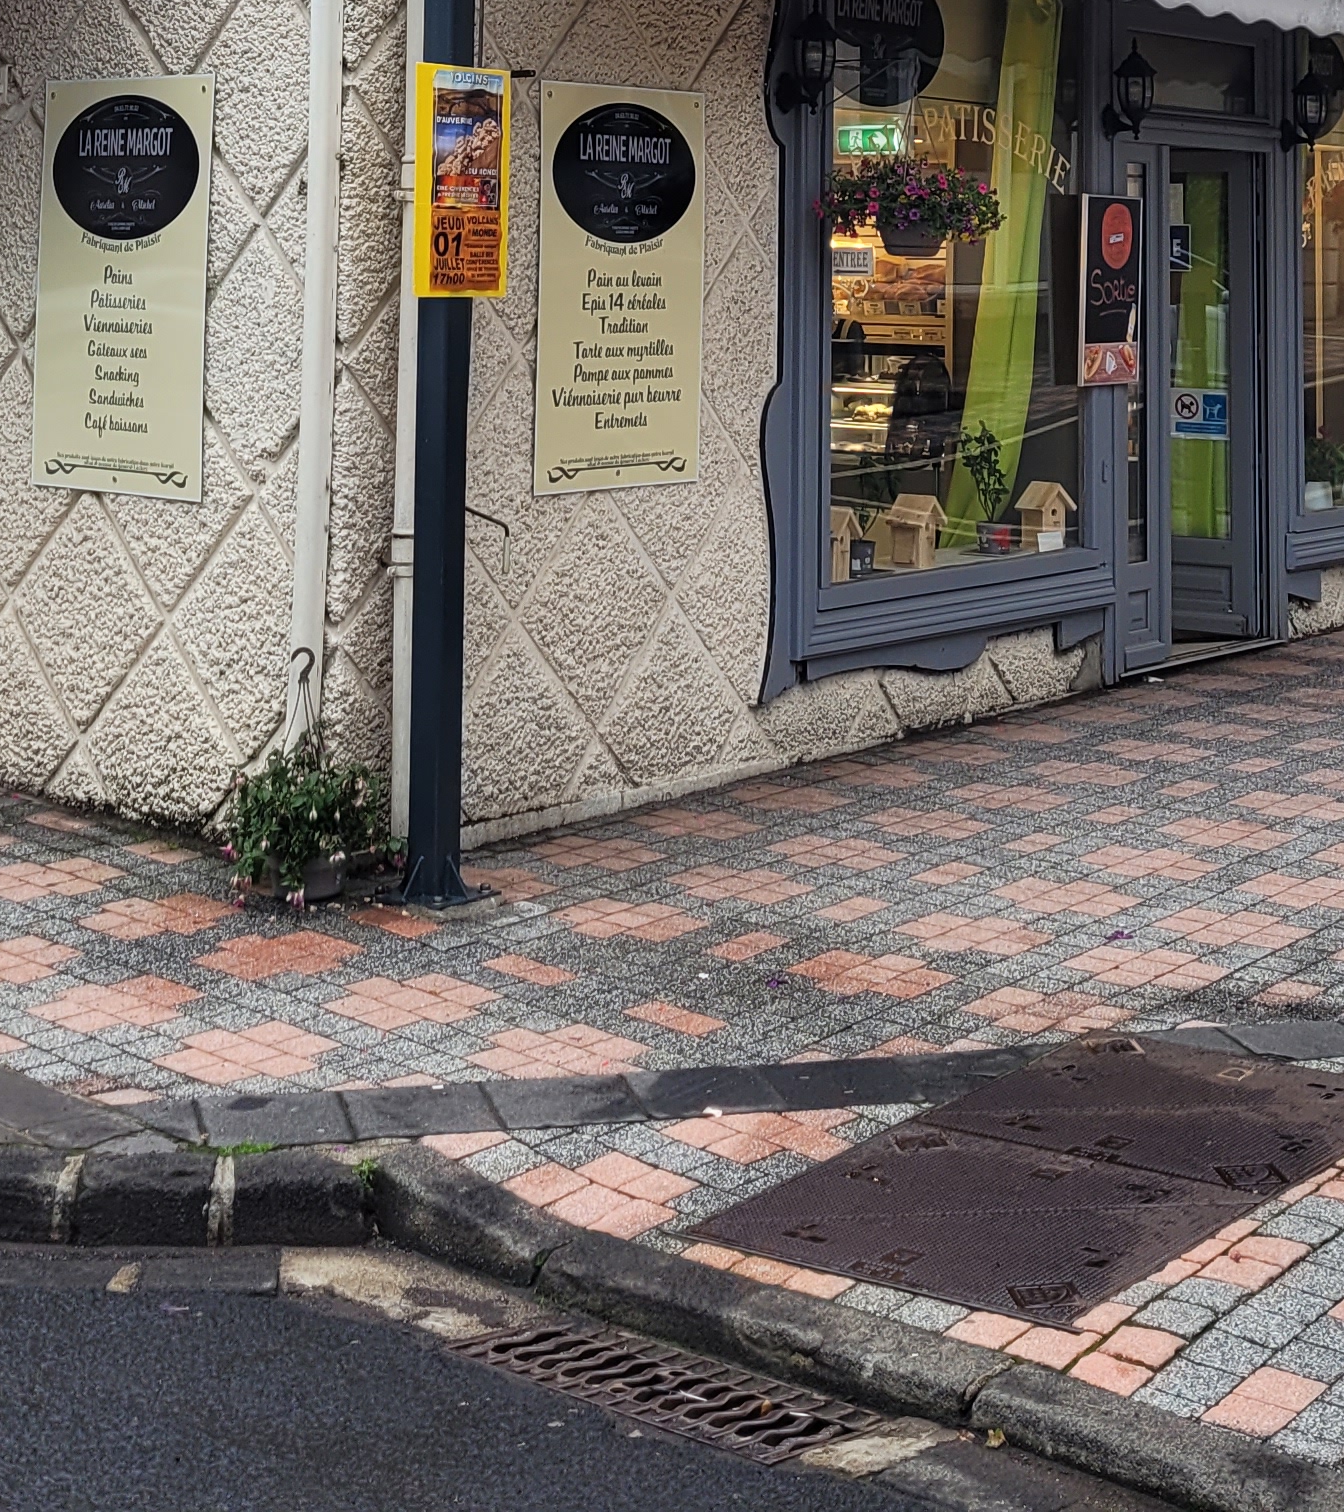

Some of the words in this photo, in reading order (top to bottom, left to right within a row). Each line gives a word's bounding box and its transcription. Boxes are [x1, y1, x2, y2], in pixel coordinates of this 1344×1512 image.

[79, 130, 92, 157] LA
[94, 128, 125, 156] REINE
[126, 128, 174, 156] MARGOT
[580, 133, 593, 160] LA
[596, 134, 626, 162] REINE
[629, 136, 671, 164] MARGOT
[924, 104, 1071, 196] PATISSERIE
[434, 216, 465, 230] JEUDI
[81, 231, 123, 254] Fabriquant
[124, 242, 134, 252] de
[135, 233, 162, 250] Plaisir
[434, 232, 462, 257] 01
[585, 234, 627, 257] Fabriquant
[628, 245, 637, 255] de
[639, 238, 664, 255] Plaisir
[103, 265, 133, 285] Pains
[434, 258, 465, 270] JUILLET
[433, 273, 465, 285] 17h00
[588, 268, 613, 288] Pain
[616, 277, 629, 288] au
[632, 270, 662, 287] levain
[90, 289, 146, 310] Pâtisseries
[582, 293, 606, 316] Epis
[609, 293, 624, 311] 14
[627, 293, 666, 311] céréales
[84, 314, 153, 335] Viennoiseries
[599, 316, 649, 334] Tradition
[87, 340, 128, 358] Gâteaux
[130, 347, 147, 359] secs
[573, 341, 602, 360] Tarte
[605, 346, 624, 358] aux
[627, 339, 674, 362] myrtilles
[95, 364, 139, 387] Snacking
[574, 363, 609, 387] Pompe
[611, 368, 631, 380] aux
[633, 365, 674, 385] pommes
[89, 388, 144, 408] Sandwiches
[552, 386, 621, 407] Viénnoiserie
[623, 391, 644, 409] pur
[646, 385, 682, 404] beurre
[85, 412, 108, 438] Café
[109, 417, 148, 434] boissons
[594, 412, 648, 429] Entremets
